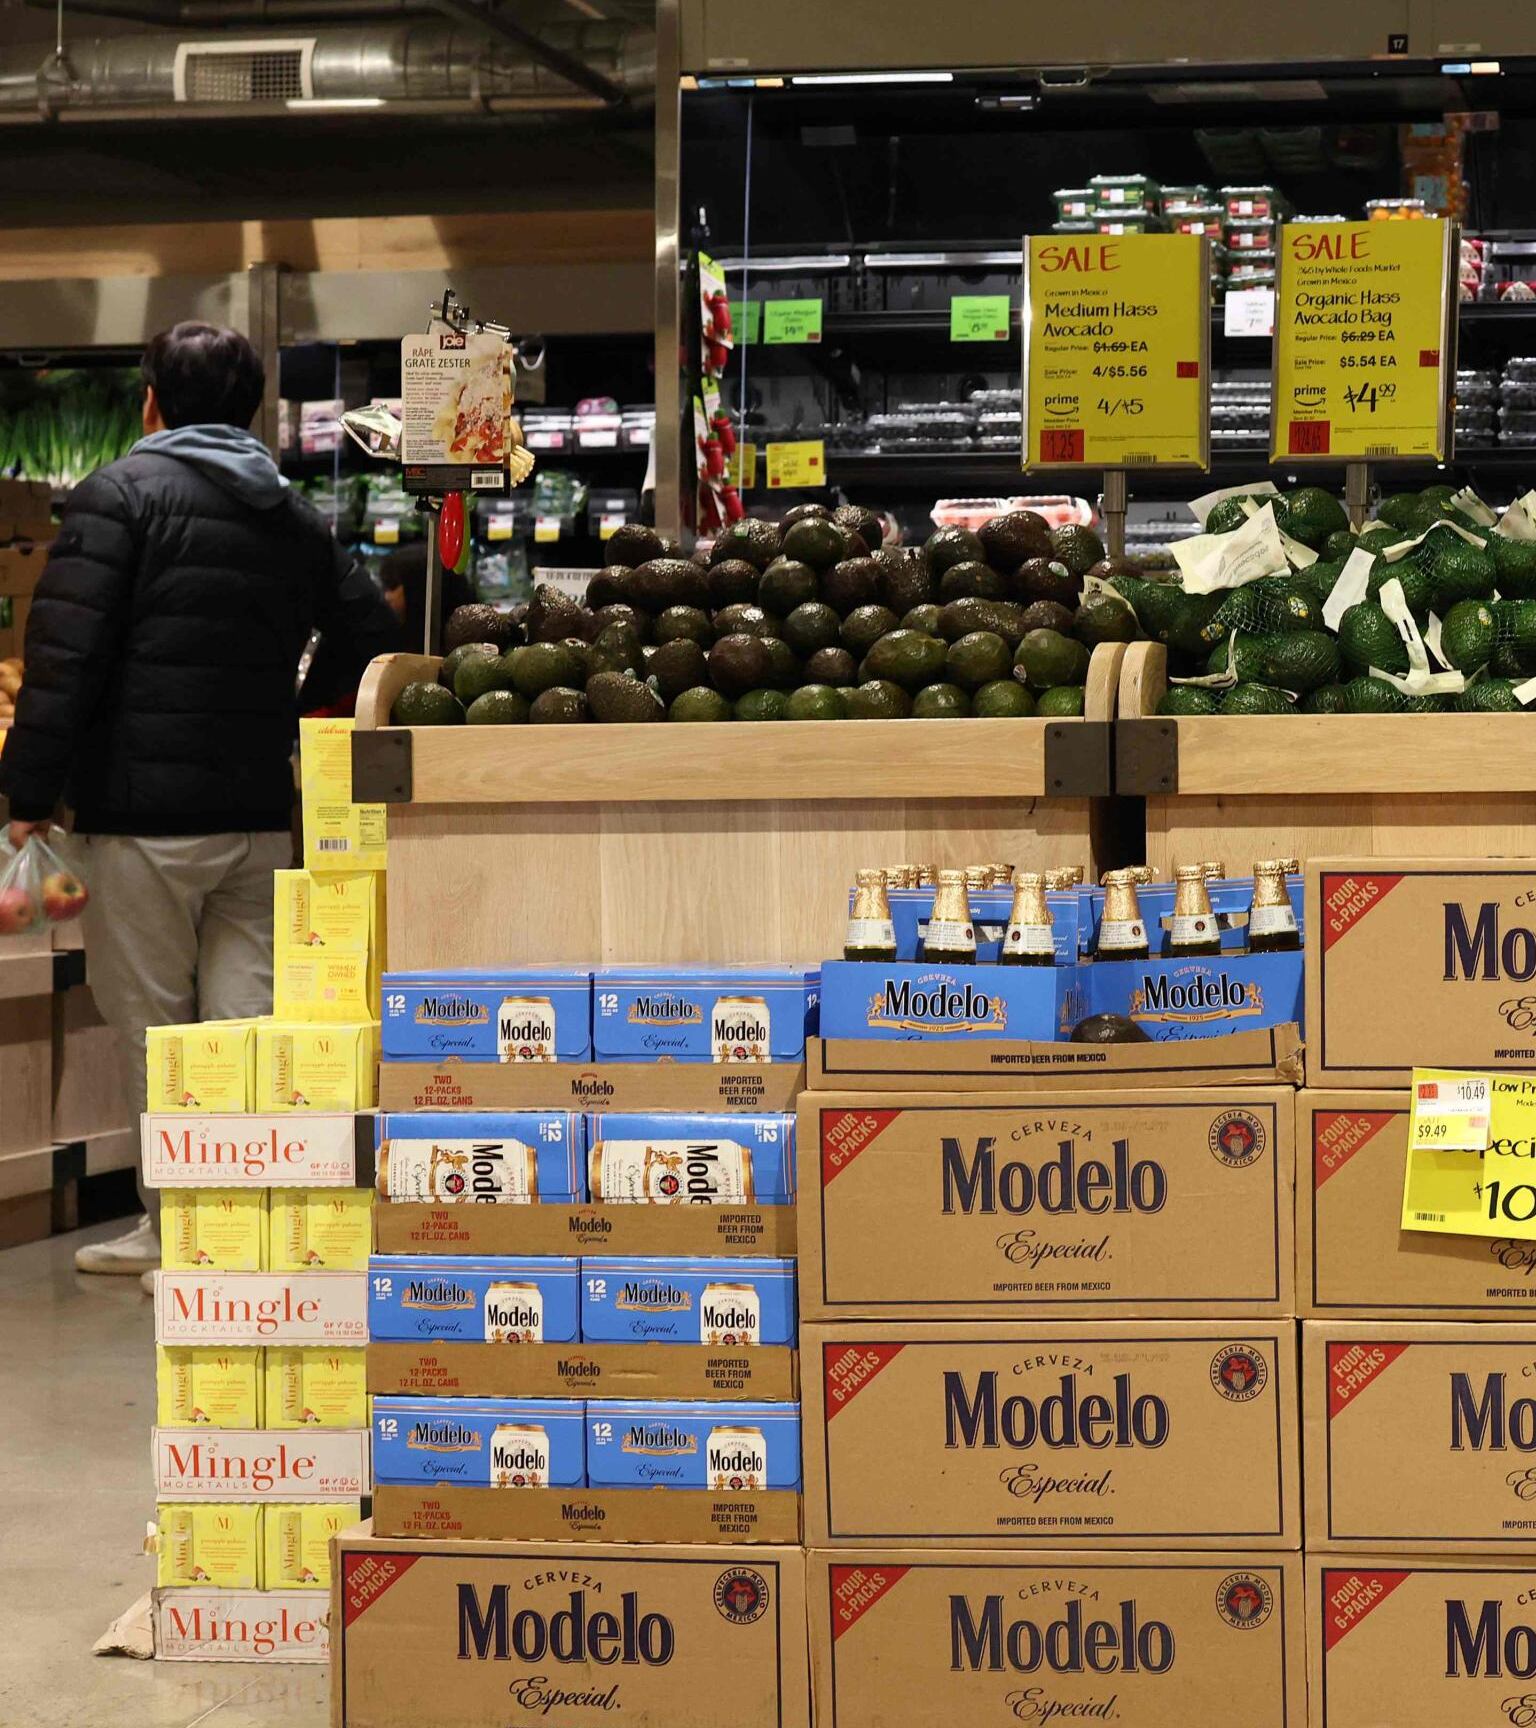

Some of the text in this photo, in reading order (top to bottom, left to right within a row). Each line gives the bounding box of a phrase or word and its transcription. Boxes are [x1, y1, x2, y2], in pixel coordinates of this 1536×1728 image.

[1392, 38, 1405, 49] 17
[1292, 230, 1371, 261] SALE
[1038, 244, 1121, 273] SALE
[1315, 266, 1324, 276] by
[1325, 265, 1348, 274] Whole
[1350, 264, 1373, 273] Foods
[1374, 264, 1401, 272] Market
[1080, 288, 1108, 296] Mexico
[1297, 278, 1321, 287] Grown
[1330, 277, 1357, 285] Mexico
[1045, 302, 1158, 318] Medium Hass
[1295, 290, 1400, 310] Organic Hass
[1043, 322, 1114, 337] Avocado
[1294, 310, 1392, 328] Avocado Bag
[1130, 341, 1148, 352] EA
[1295, 334, 1337, 343] Regular Price:
[1378, 330, 1395, 342] EA
[405, 359, 471, 368] GRATE ZESTER
[1092, 365, 1148, 379] 4/$5.56
[1339, 355, 1397, 369] $5.54 EA
[1044, 394, 1079, 407] prime
[1294, 384, 1327, 398] prime
[1326, 876, 1360, 914] FOUR
[1329, 880, 1380, 933] 6-PACKS
[884, 978, 991, 1020] Modelo
[1142, 972, 1246, 1012] Modelo
[386, 995, 480, 1019] 12 Modelo
[599, 994, 694, 1018] 12 Modelo
[500, 1019, 552, 1041] Modelo
[714, 1019, 767, 1041] Modelo
[1494, 1049, 1535, 1059] IMPORTED
[424, 1086, 462, 1095] 12-PACKS
[433, 1075, 452, 1085] TWO
[571, 1078, 614, 1096] Modelo
[718, 1086, 765, 1095] BEER FROM
[720, 1076, 763, 1085] IMPORTED
[1457, 1083, 1486, 1101] $10.49
[1492, 1080, 1518, 1093] Low
[726, 1096, 758, 1105] MEXICO
[826, 1112, 859, 1148] FOUR
[1010, 1120, 1094, 1143] CERVEZA
[1418, 1124, 1448, 1138] $9.49
[829, 1115, 879, 1168] 6-PACKS
[154, 1128, 307, 1177] Mingle
[154, 1168, 239, 1176] MOCKTAILS
[940, 1136, 1168, 1216] Modelo
[996, 1229, 1113, 1270] Especial.
[167, 1287, 320, 1336] Mingle
[167, 1326, 252, 1334] MOCKTAILS
[942, 1370, 1170, 1450] Modelo
[163, 1443, 316, 1492] Mingle
[163, 1481, 248, 1489] MOCKTAILS
[999, 1463, 1116, 1504] Especial.
[347, 1556, 378, 1590] FOUR
[524, 1571, 603, 1593] CERVEZA
[350, 1560, 397, 1610] 6-PACKS
[165, 1607, 318, 1656] Mingle
[456, 1583, 675, 1666] Modelo
[948, 1594, 1176, 1675] Modelo
[509, 1676, 622, 1715] Especial.
[1004, 1687, 1122, 1728] Especial.
